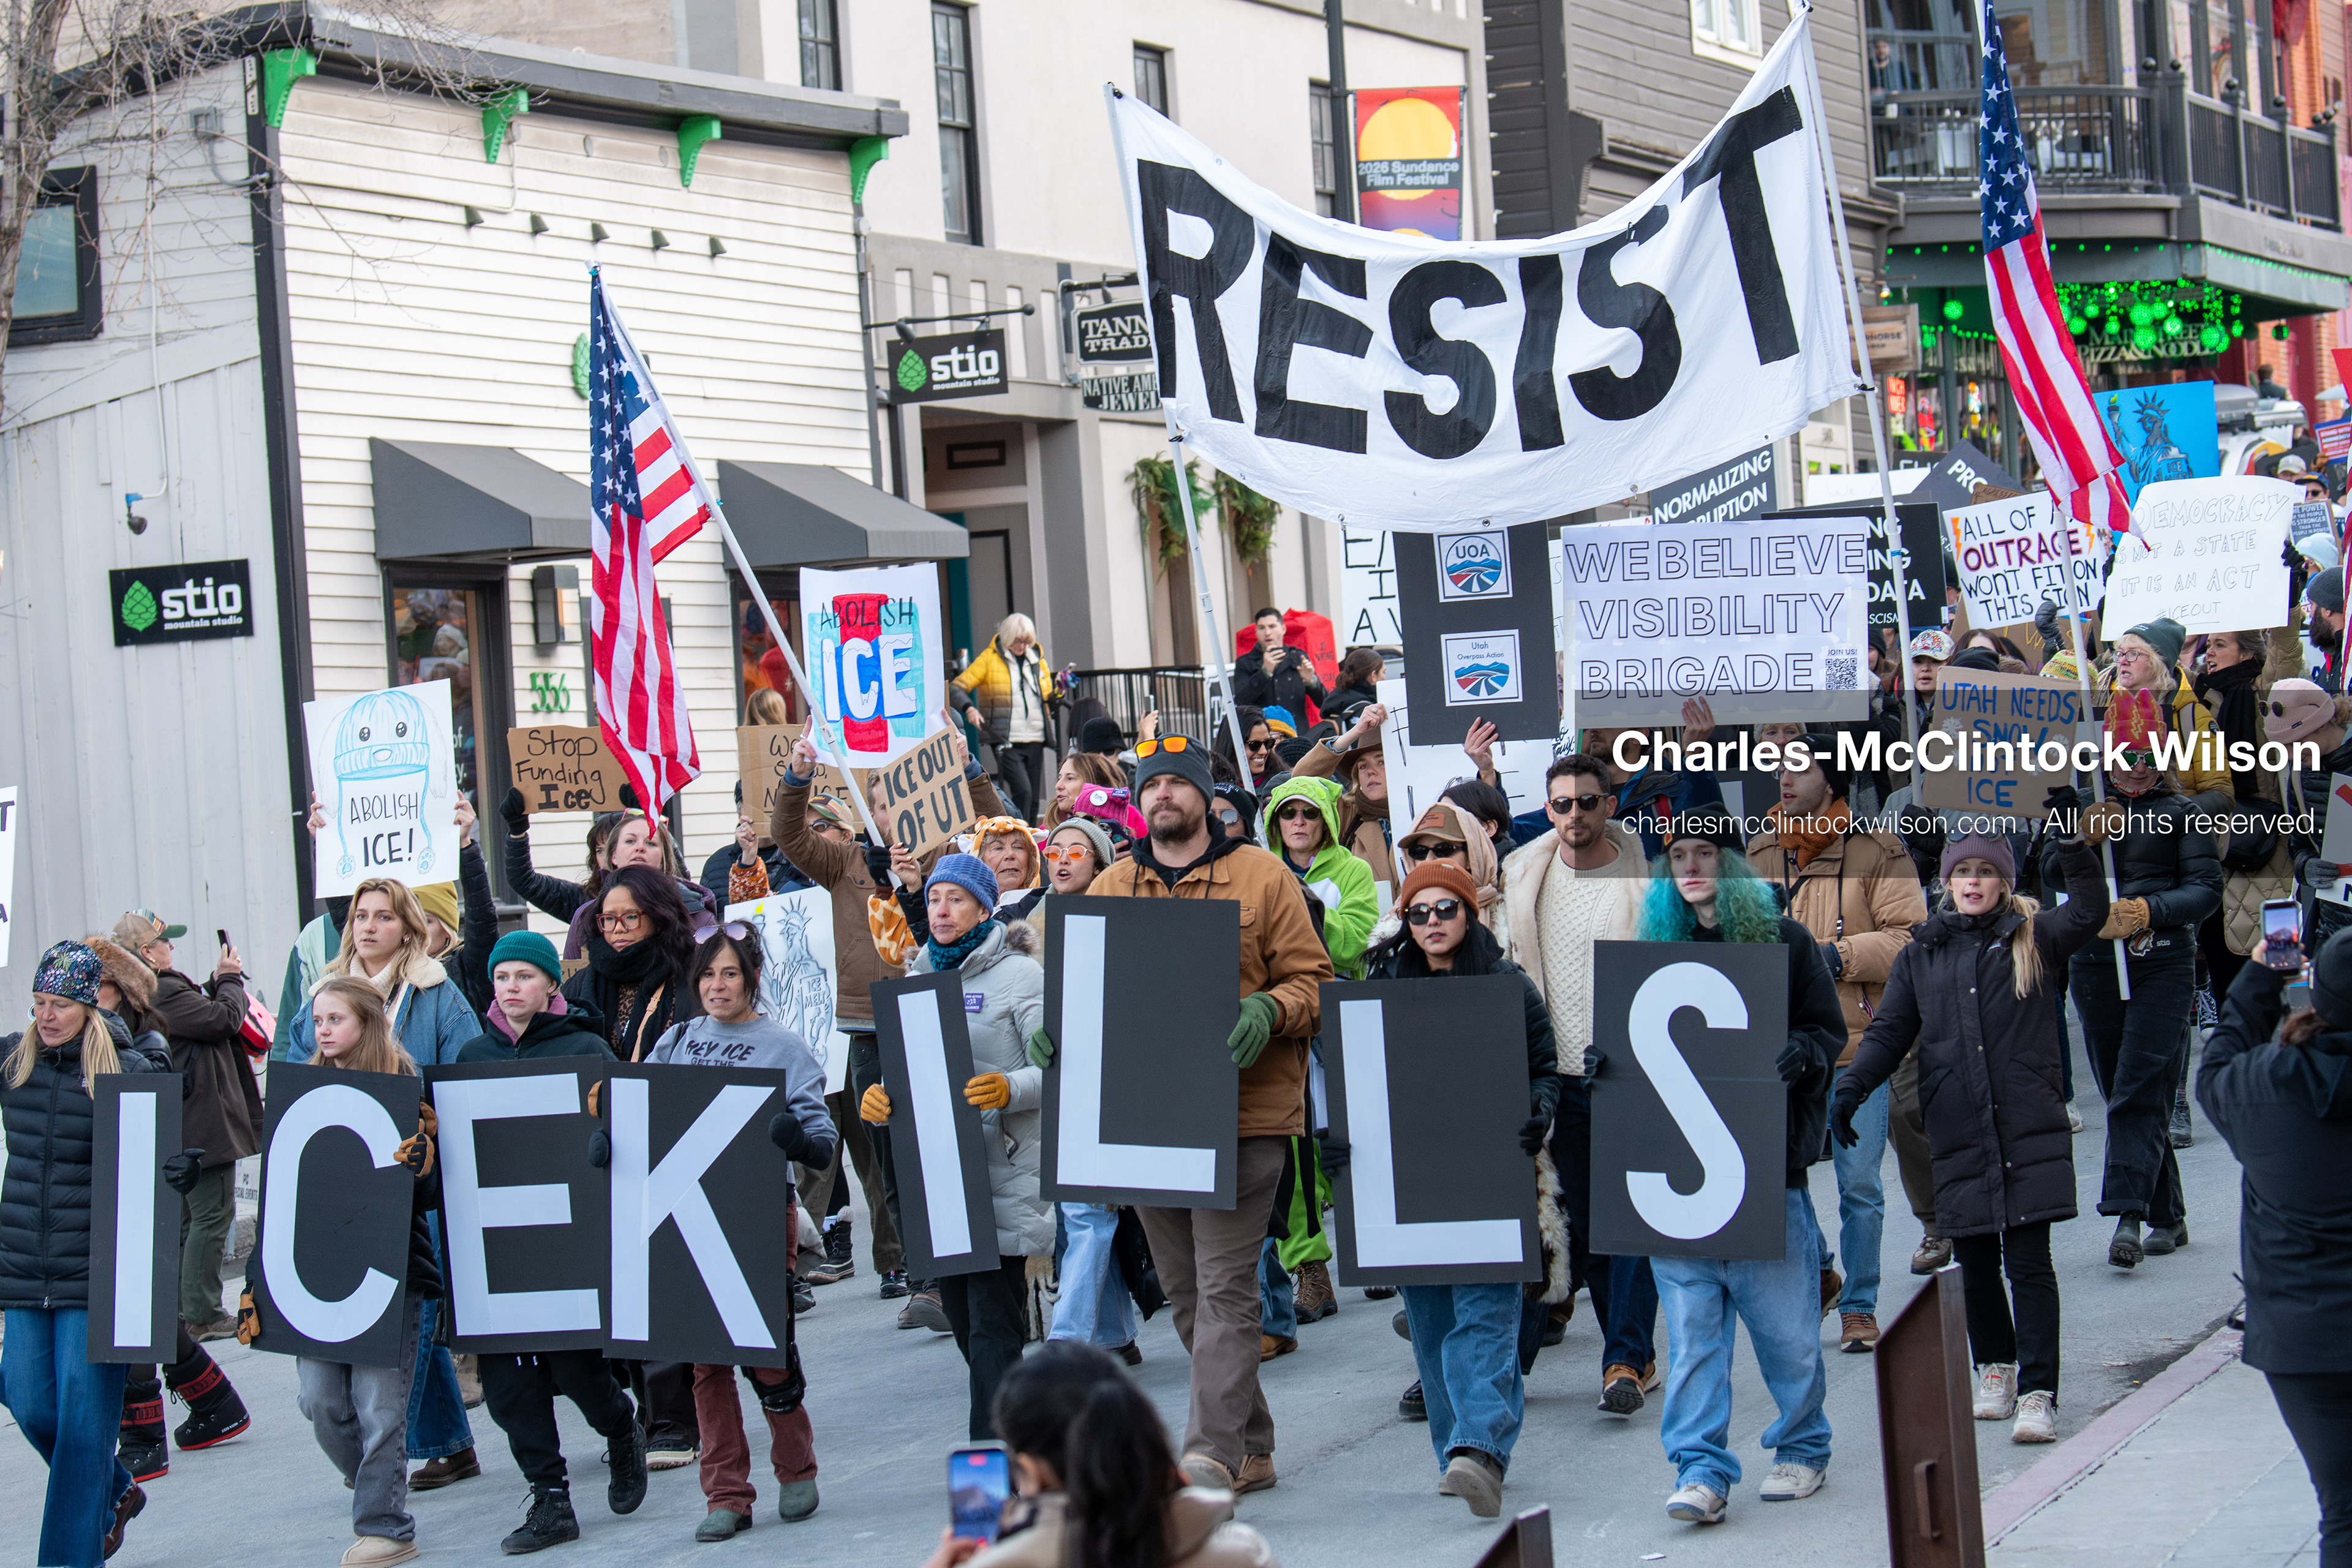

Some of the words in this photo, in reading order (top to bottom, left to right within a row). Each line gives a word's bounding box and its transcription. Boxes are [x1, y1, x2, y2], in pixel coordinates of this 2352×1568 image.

[1358, 161, 1389, 175] 2026
[1391, 160, 1460, 173] Sundance
[1366, 173, 1395, 187] Film
[1396, 172, 1449, 185] Festival
[1137, 85, 1804, 459] RESIST
[930, 344, 1000, 382] stio
[932, 379, 972, 391] mountain
[973, 375, 1000, 386] studio
[1083, 377, 1131, 398] NATIVE
[2166, 461, 2182, 473] ICE
[1654, 450, 1772, 525] NORMALIZING
[1964, 513, 2007, 542] ALL
[2010, 506, 2037, 532] OF
[2132, 493, 2291, 533] DEMOCRACY
[1455, 544, 1491, 560] UOA
[2174, 540, 2185, 557] A
[2194, 529, 2257, 557] STATE
[2073, 557, 2098, 582] ON
[2121, 576, 2140, 598] IT
[2146, 574, 2163, 593] IS
[2174, 571, 2197, 593] AN
[2207, 564, 2261, 592] ACT
[161, 577, 243, 619] stio
[820, 595, 914, 631] ABOLISH
[1978, 593, 2035, 623] THIS
[164, 618, 210, 630] mountain
[212, 616, 243, 626] studio
[1579, 592, 1845, 641] VISIBILITY
[1457, 651, 1487, 661] Overpass
[1471, 641, 1490, 650] Utah
[529, 672, 571, 712] 556
[821, 633, 918, 724] ICE
[1580, 652, 1814, 701] BRIGADE
[1942, 682, 1997, 715] UTAH
[2010, 687, 2078, 725] NEEDS
[527, 729, 598, 769] Stop
[516, 758, 606, 805] Funding
[883, 758, 918, 809] ICE
[917, 732, 955, 784] OUT
[350, 791, 419, 825] ABOLISH
[1967, 776, 2019, 808] ICE
[896, 799, 927, 856] OF
[930, 773, 968, 835] UT
[362, 827, 414, 868] ICE!
[2113, 908, 2123, 927] KINCO
[804, 990, 826, 1009] MELT
[807, 978, 822, 993] ICE
[685, 1039, 720, 1058] HEY
[720, 1042, 756, 1061] ICE
